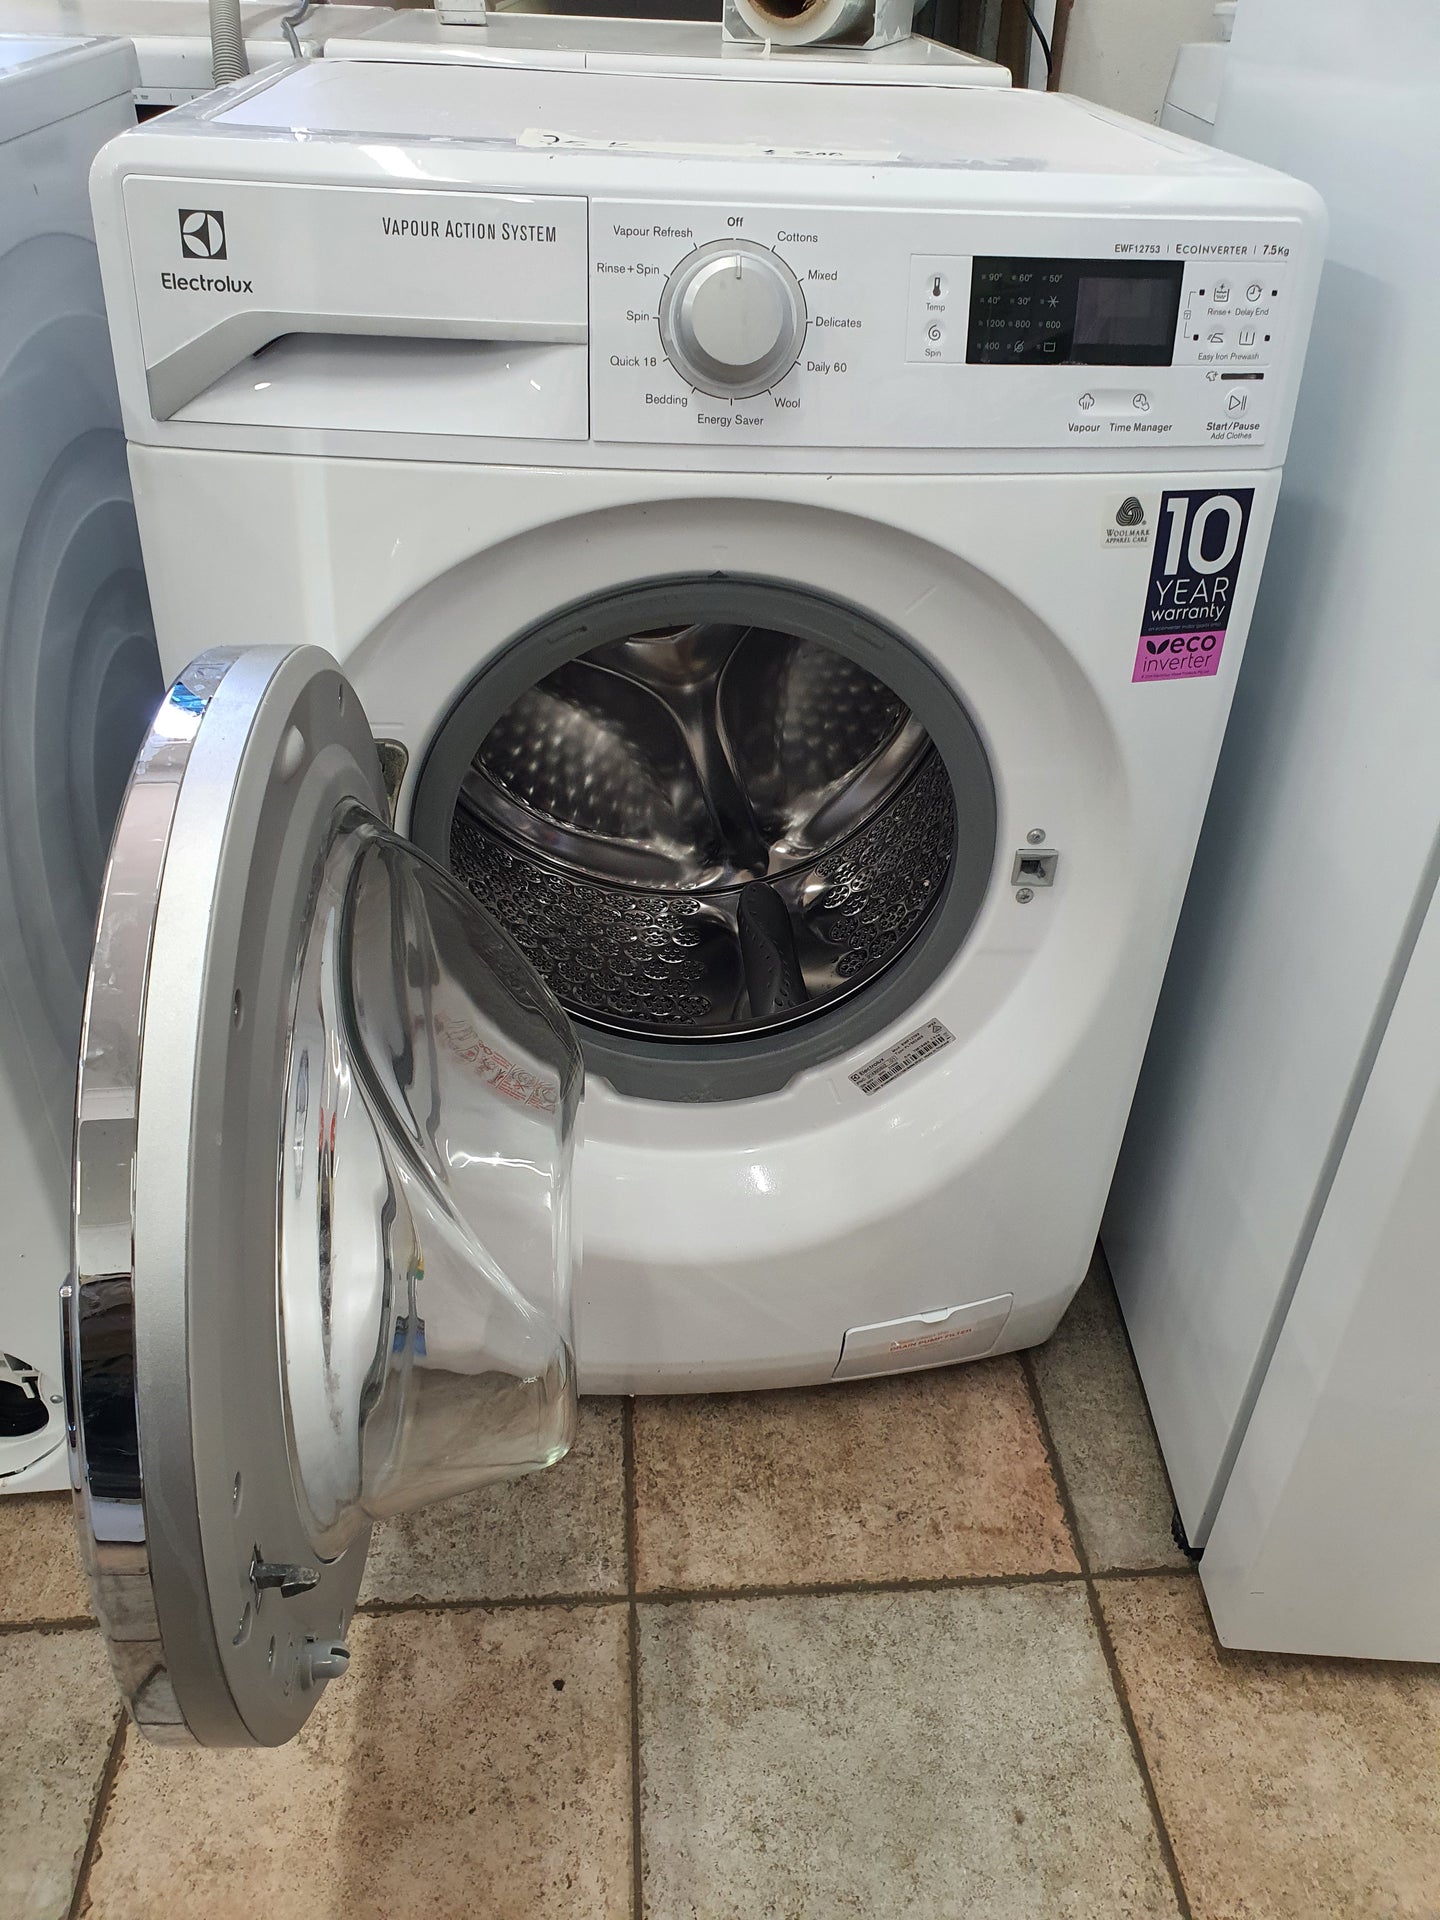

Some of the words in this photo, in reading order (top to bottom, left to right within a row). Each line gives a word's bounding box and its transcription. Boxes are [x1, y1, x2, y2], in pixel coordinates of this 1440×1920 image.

[727, 217, 744, 227] Off
[382, 216, 440, 237] VAPOUR
[444, 220, 496, 240] ACTION
[501, 222, 557, 243] SYSTEM
[613, 225, 650, 237] Vapour
[653, 227, 693, 238] Refresh
[777, 231, 818, 243] Cottons
[1114, 243, 1161, 254] EWF12753
[1175, 243, 1247, 256] ECOINVERTER
[1262, 244, 1290, 257] 7.5Kg
[808, 270, 838, 281] Mixed
[161, 272, 254, 294] Electrolux
[926, 302, 946, 313] Temp
[1235, 308, 1254, 318] Delay
[1255, 308, 1270, 316] End
[626, 310, 650, 322] Spin
[815, 316, 862, 329] Delicates
[986, 320, 1006, 328] 1200
[984, 342, 1000, 350] 400
[924, 348, 942, 359] Spin
[1198, 353, 1214, 362] Easy
[1215, 353, 1229, 361] Iron
[1230, 353, 1260, 361] Prewash
[609, 355, 641, 368] Quick
[644, 356, 657, 367] 18
[807, 361, 831, 374] Daily
[833, 363, 848, 373] 60
[645, 394, 688, 407] Bedding
[774, 398, 801, 409] Wool
[697, 414, 732, 427] Energy
[735, 415, 764, 426] Saver
[1068, 423, 1101, 433] Vapour
[1109, 423, 1132, 432] Time
[1133, 423, 1173, 433] Manager
[1206, 422, 1260, 432] Start/Pause
[1210, 432, 1226, 440] Add
[1226, 432, 1252, 440] Clothes
[1106, 529, 1150, 537] WOOLMARK
[1165, 495, 1243, 576] 10
[1156, 577, 1230, 606] YEAR
[1151, 603, 1226, 622] warranty
[1170, 635, 1216, 653] eco
[1142, 653, 1212, 672] inverter
